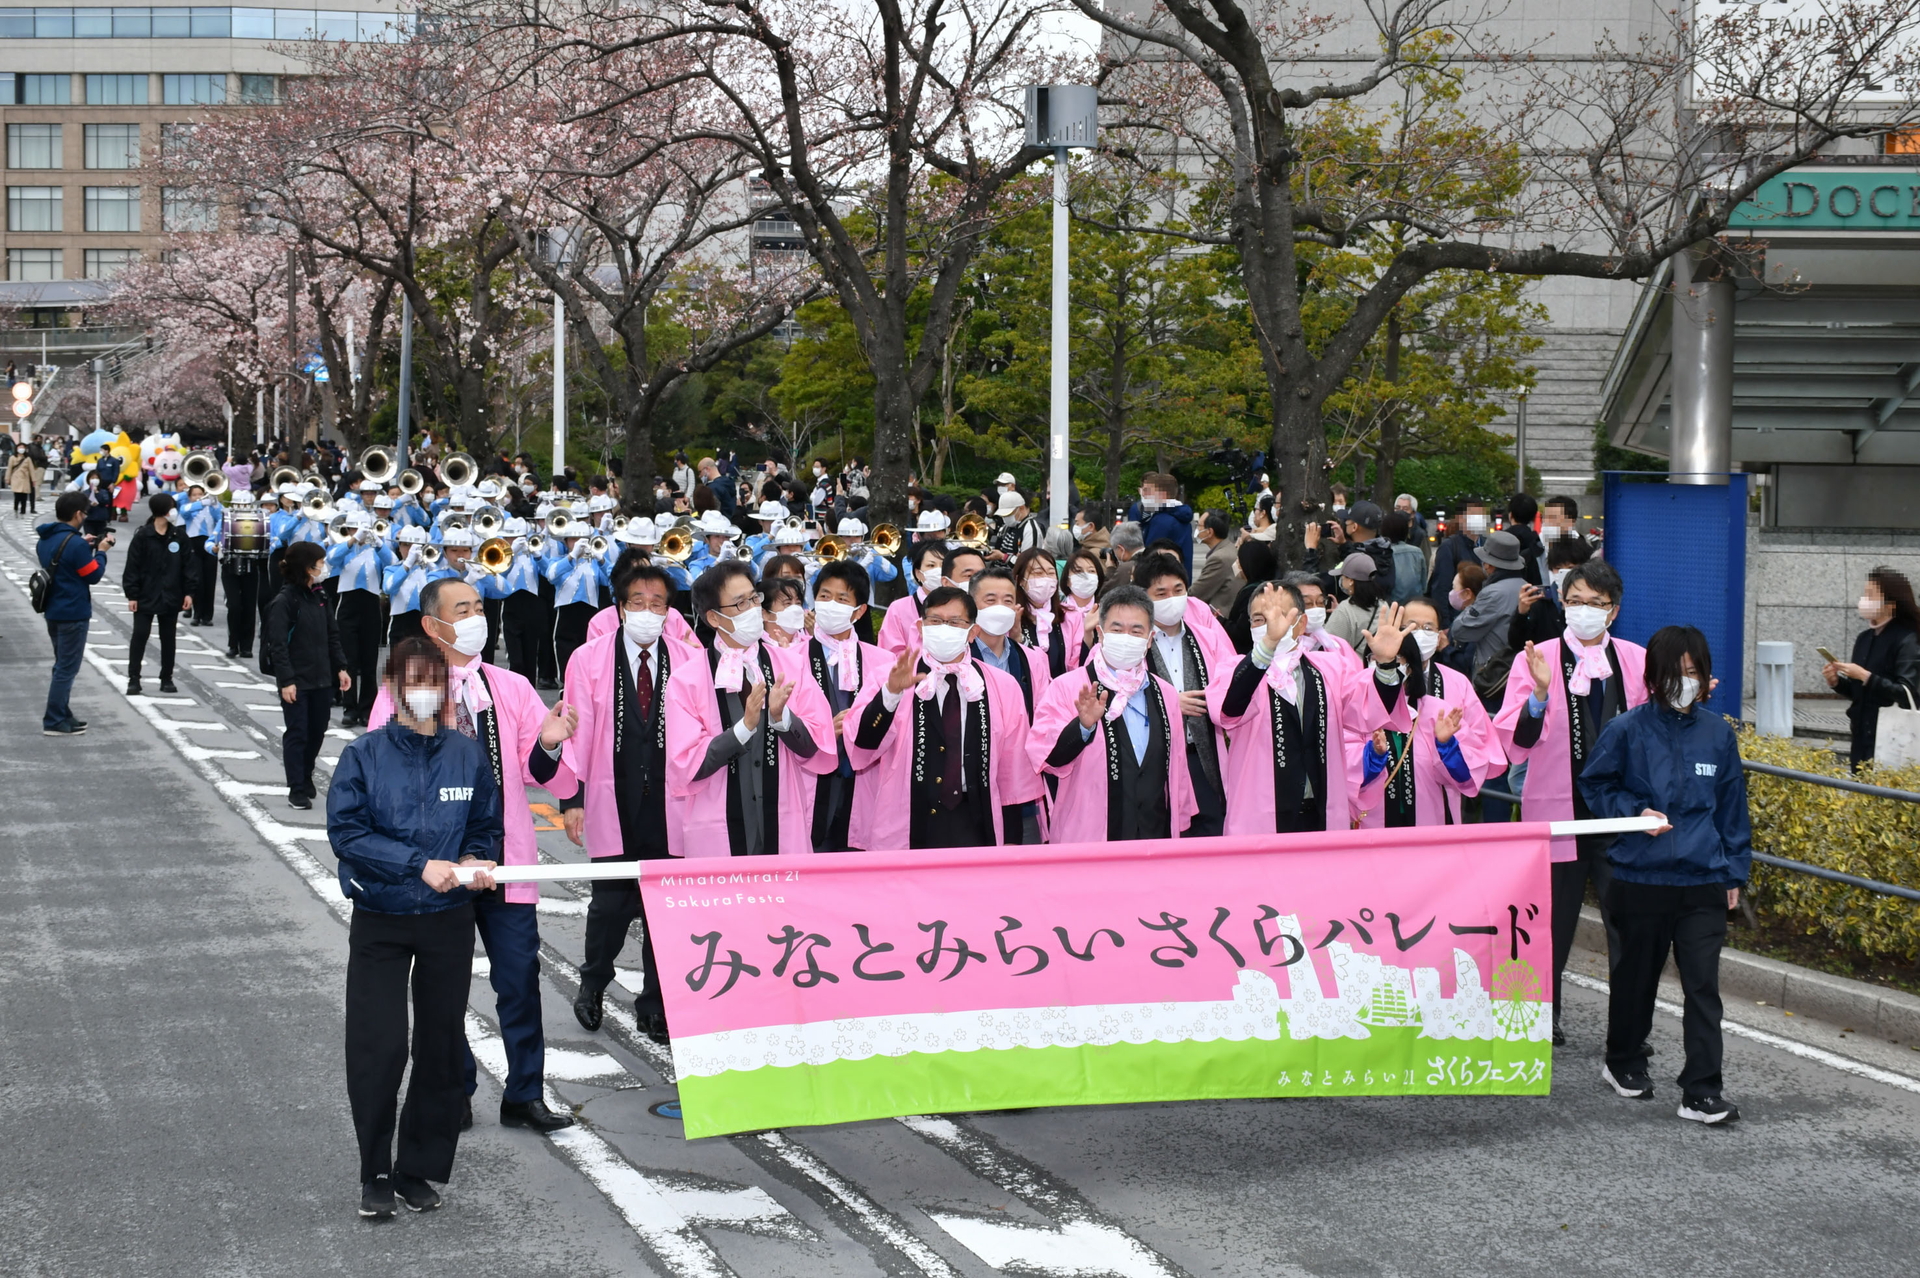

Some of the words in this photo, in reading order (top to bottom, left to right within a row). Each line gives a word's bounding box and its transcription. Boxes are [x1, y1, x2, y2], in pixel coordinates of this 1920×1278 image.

[1895, 79, 1920, 91] B2
[439, 787, 475, 802] STAFF
[660, 871, 779, 887] MinatoMirai
[785, 870, 799, 881] 21
[665, 893, 785, 908] SakuraFesta
[685, 903, 1539, 1000] みなとみらいさくらパレード
[1426, 1056, 1546, 1086] さくらフェスタ
